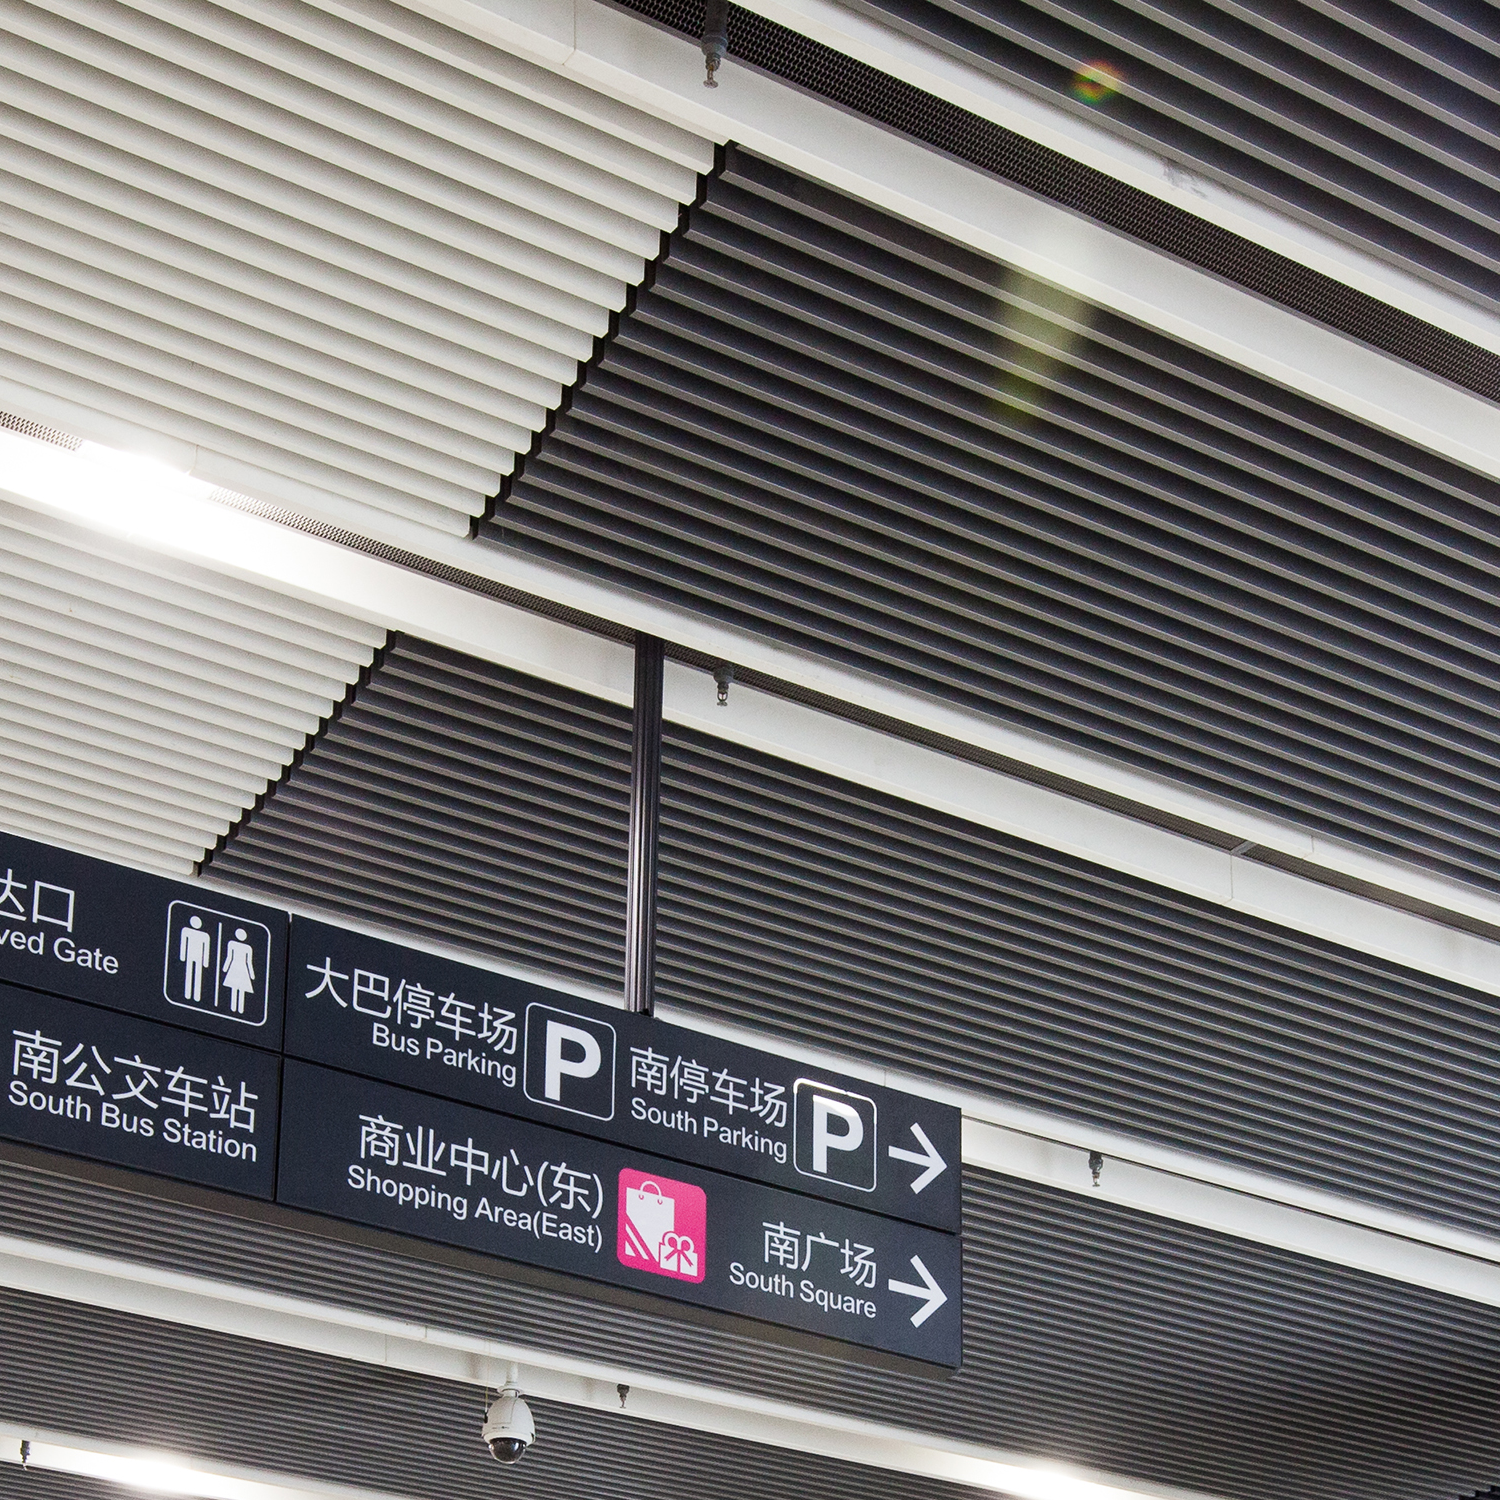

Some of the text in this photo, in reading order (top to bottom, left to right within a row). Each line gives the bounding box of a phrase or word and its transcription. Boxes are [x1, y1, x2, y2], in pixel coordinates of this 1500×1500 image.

[53, 936, 120, 975] Gate
[304, 956, 518, 1056] 大巴停车场
[12, 1029, 259, 1134] 南公交车站
[372, 1021, 517, 1088] Bus Parking
[544, 1019, 602, 1102] P
[629, 1046, 788, 1129] 南停车场
[7, 1080, 258, 1163] South Bus Station
[630, 1096, 788, 1165] South Parking
[812, 1094, 864, 1174] P
[358, 1114, 604, 1220] 商业中心(东)
[347, 1164, 603, 1254] Shopping Area(East)
[729, 1261, 877, 1319] South Square
[762, 1220, 877, 1290] 南广场
